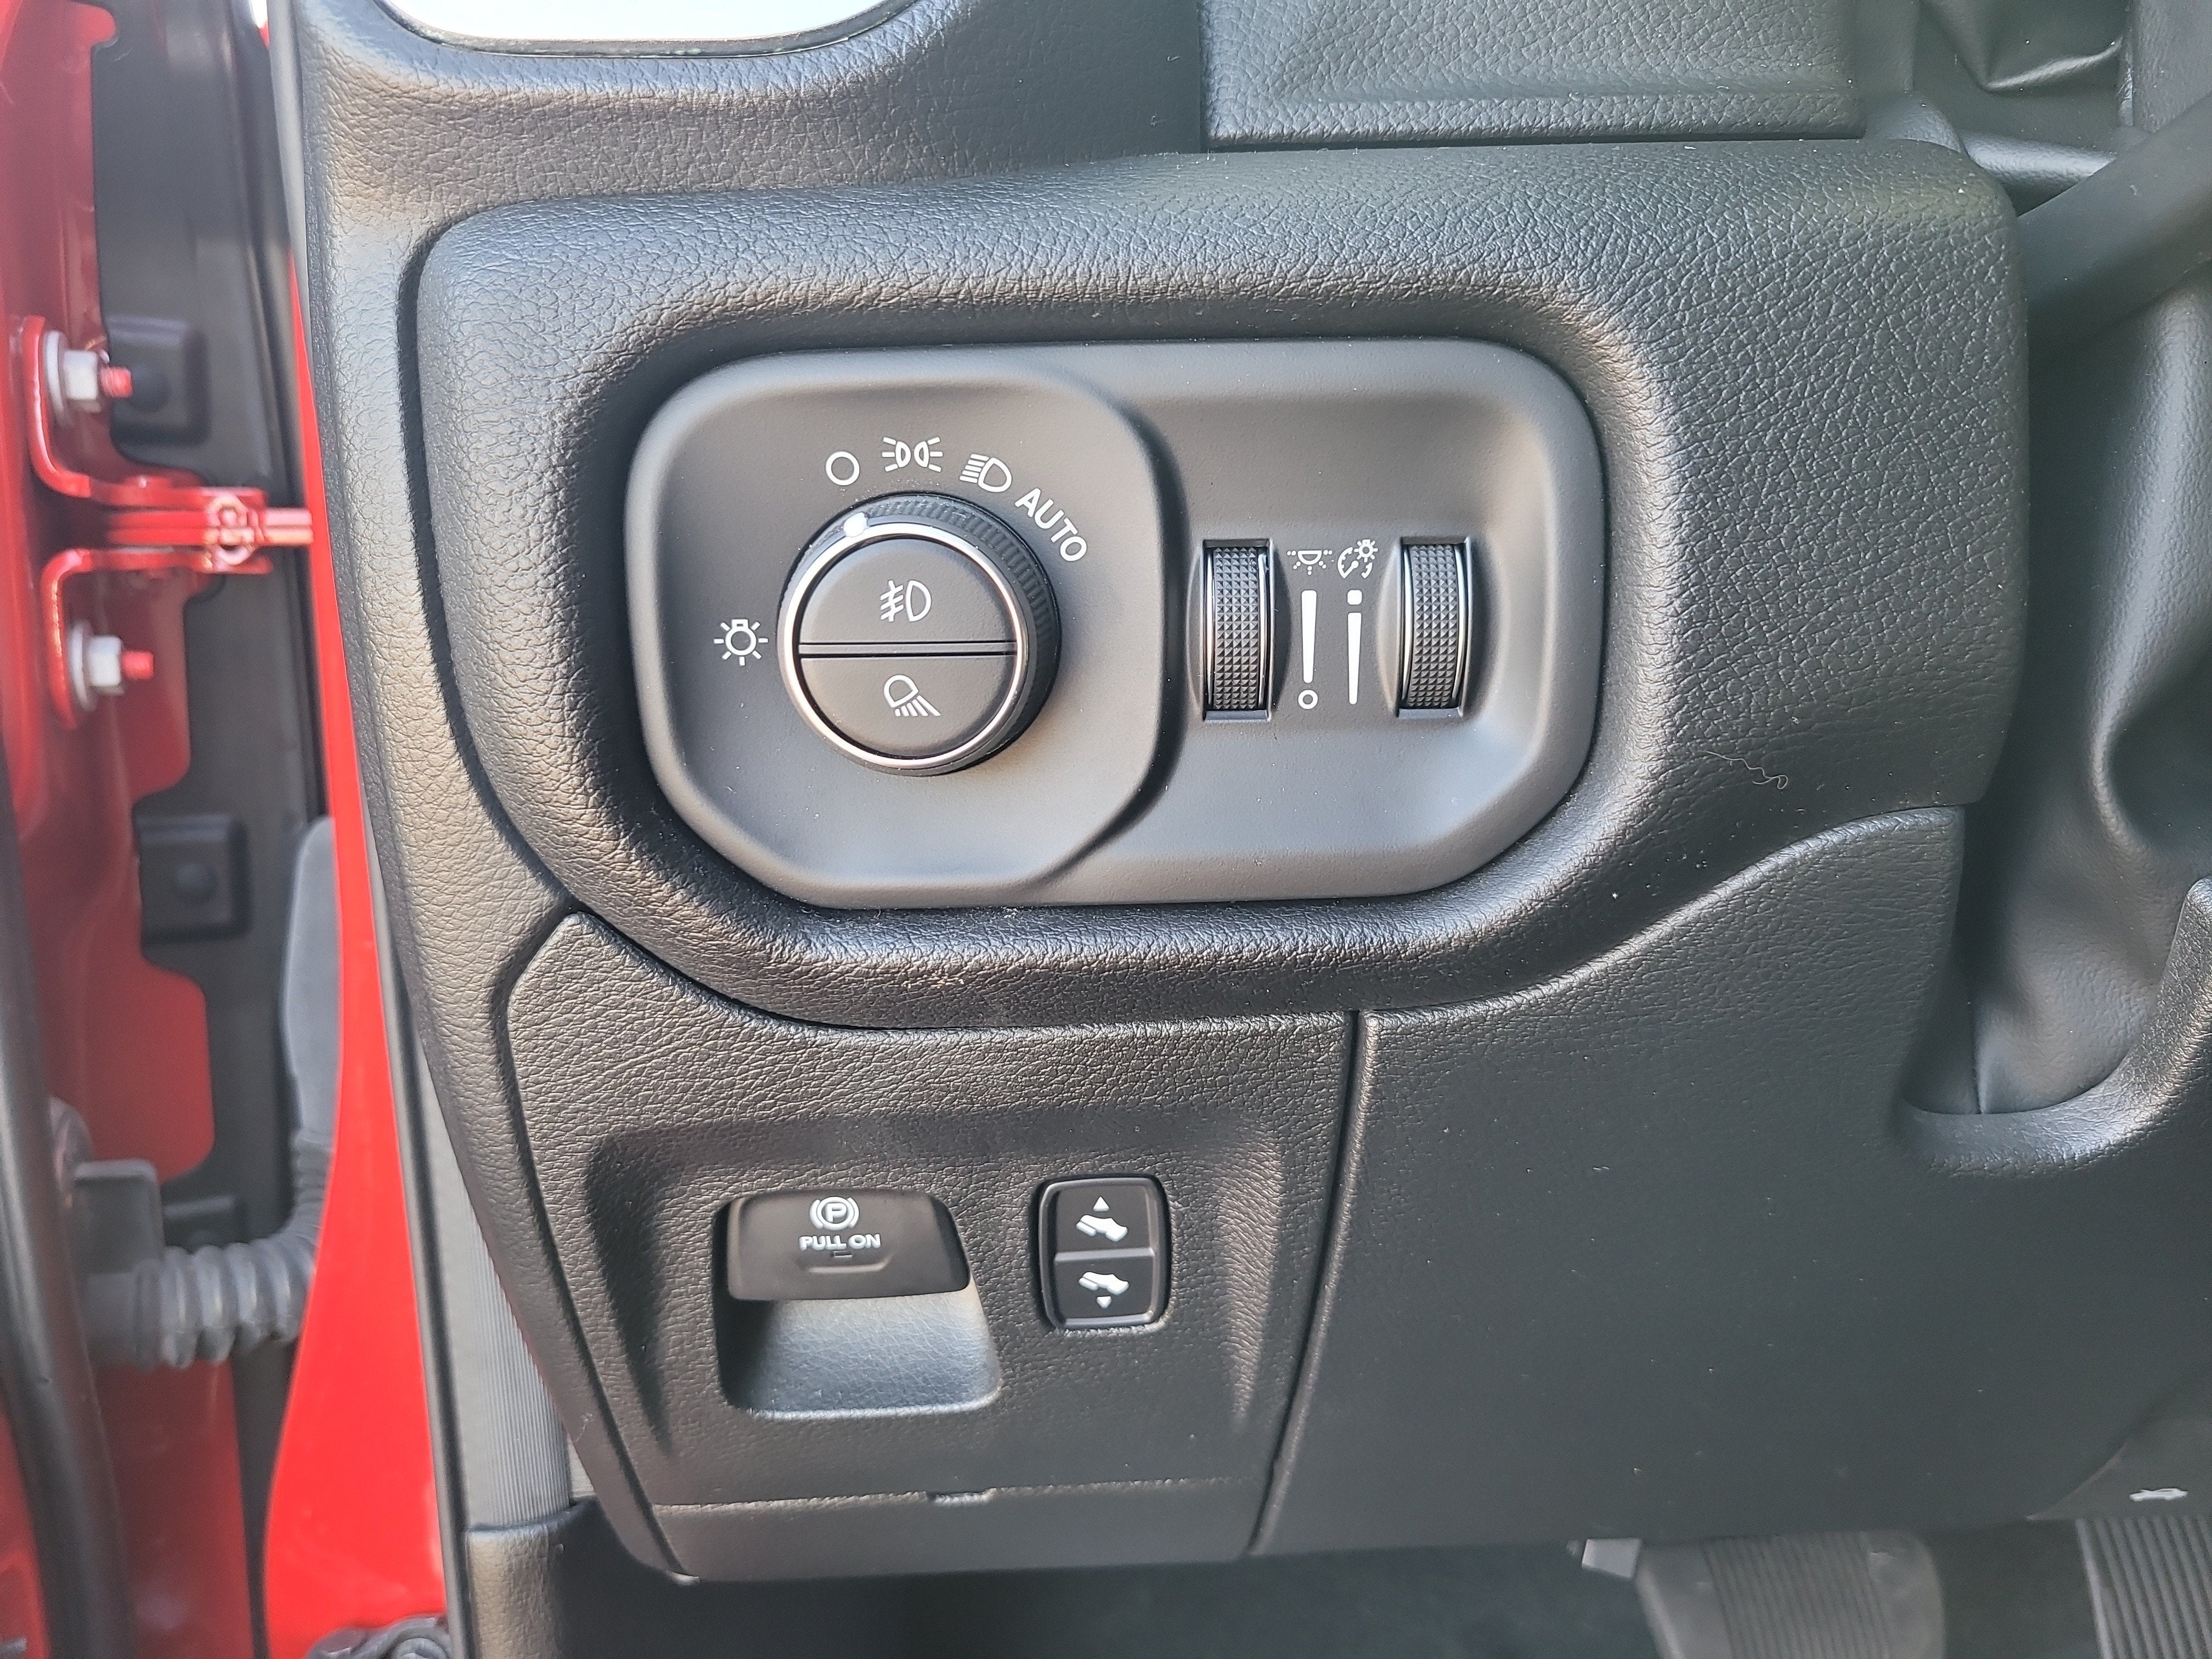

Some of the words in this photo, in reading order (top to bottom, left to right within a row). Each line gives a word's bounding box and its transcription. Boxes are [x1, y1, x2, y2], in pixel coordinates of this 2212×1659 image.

[1014, 488, 1087, 561] AUTO
[825, 1202, 848, 1222] P
[798, 1235, 847, 1250] PULL
[848, 1233, 881, 1249] ON
